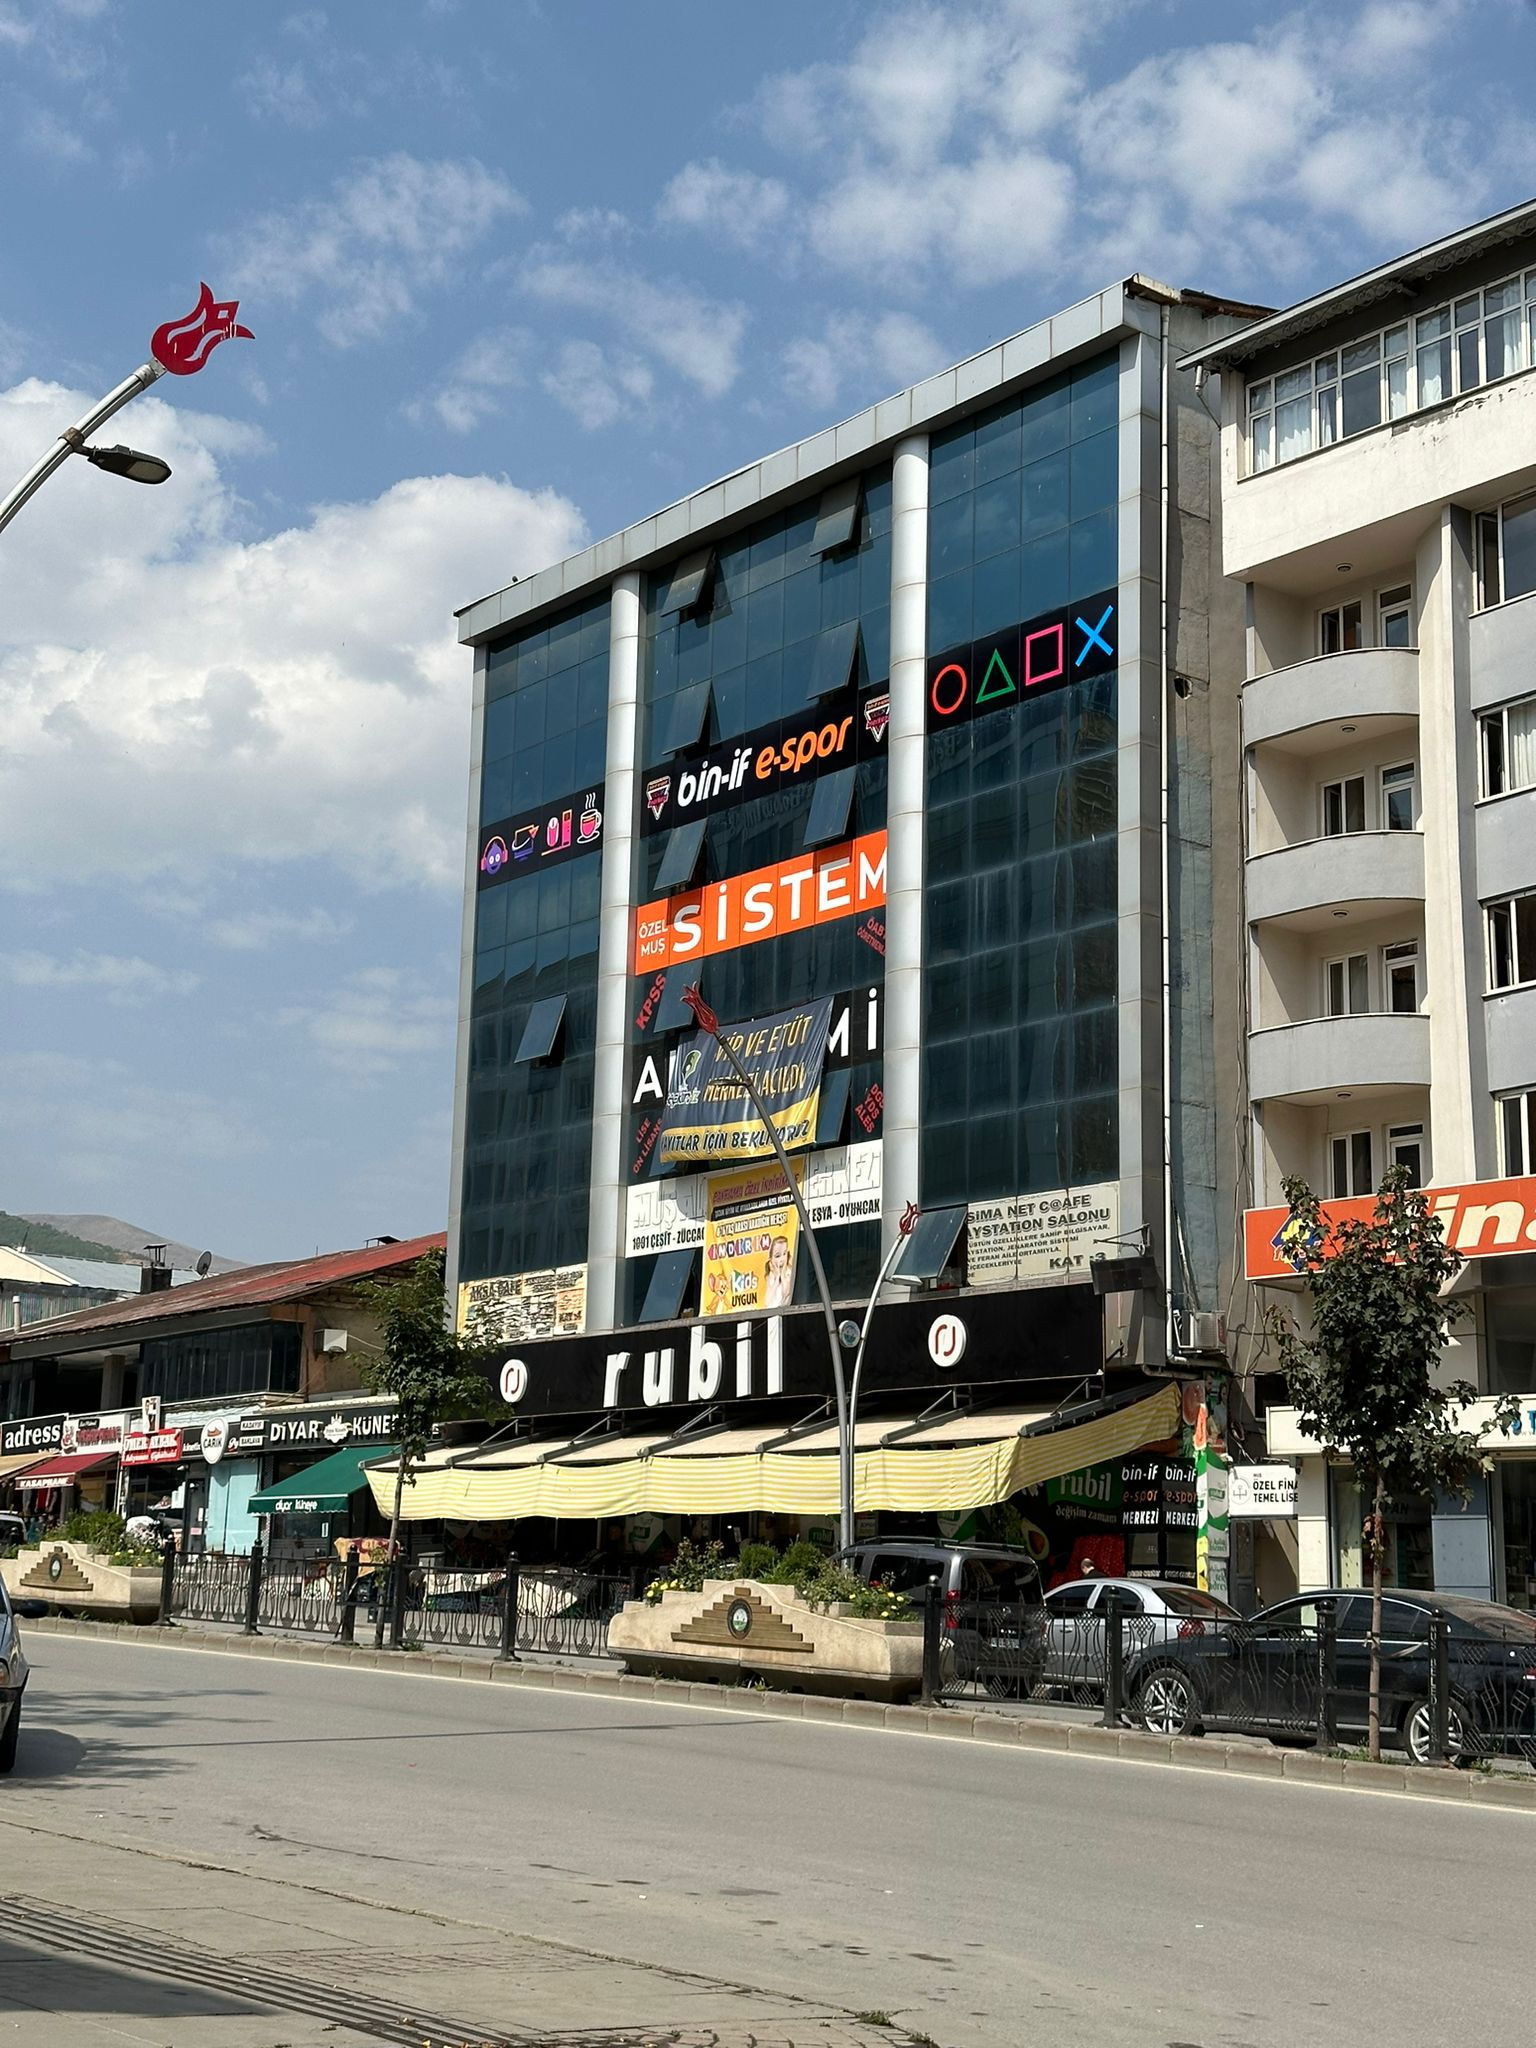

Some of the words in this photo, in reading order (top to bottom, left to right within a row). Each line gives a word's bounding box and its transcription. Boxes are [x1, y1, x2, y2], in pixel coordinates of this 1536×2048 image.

[677, 747, 752, 808] bin-if
[755, 716, 853, 779] e-spor
[672, 847, 888, 953] SİSTEM
[638, 919, 669, 940] ÖZEL
[640, 936, 667, 957] MUŞ
[635, 974, 666, 1030] KPSS
[744, 1029, 769, 1058] VE
[767, 1013, 813, 1054] ETÜT
[703, 1129, 728, 1155] İÇİN
[812, 1206, 832, 1224] EŞYA
[839, 1199, 880, 1219] OYUNCAK
[1007, 1202, 1037, 1220] NET
[1039, 1193, 1092, 1214] C@AFE
[1047, 1207, 1112, 1228] SALONU
[1048, 1254, 1084, 1270] KAT
[731, 1293, 758, 1308] UYGUN
[603, 1314, 783, 1408] rubil
[5, 1423, 60, 1450] adress
[270, 1420, 321, 1442] DİYAR
[1122, 1463, 1159, 1482] bin-if
[1165, 1463, 1197, 1482] bin-if
[1060, 1468, 1112, 1501] rubil
[1123, 1489, 1158, 1503] e-spor
[1253, 1493, 1280, 1503] TEMEL
[1122, 1508, 1159, 1526] MERKEZİ
